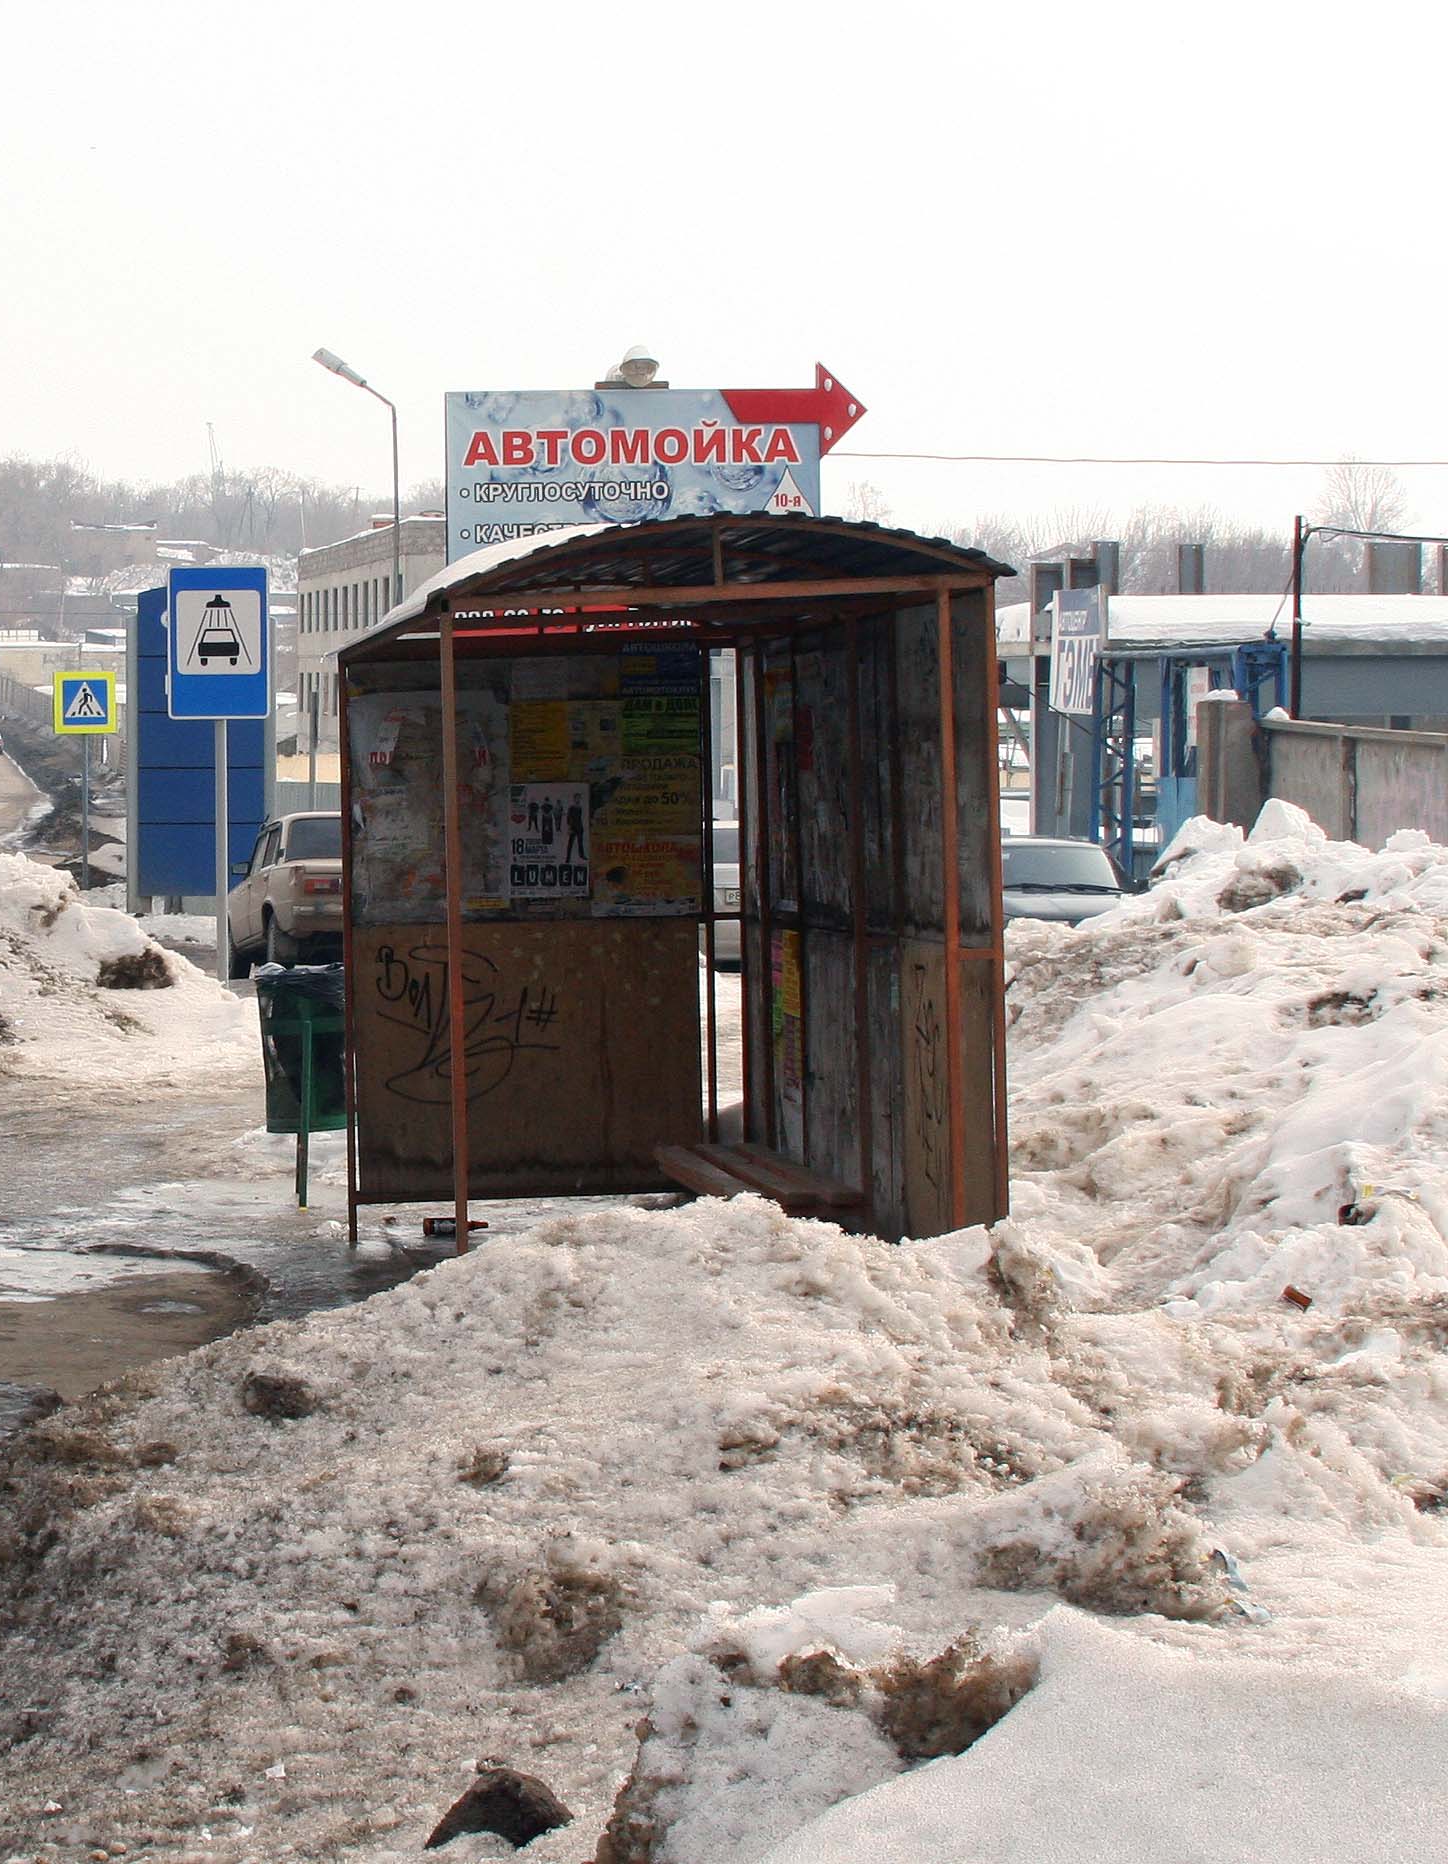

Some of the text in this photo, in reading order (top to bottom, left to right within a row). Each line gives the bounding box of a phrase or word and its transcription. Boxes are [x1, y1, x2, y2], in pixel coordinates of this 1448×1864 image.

[463, 420, 800, 466] АВТОМОЙКА
[475, 481, 669, 502] КРУГЛОСУТОЧНО
[512, 838, 524, 855] 18
[512, 868, 586, 885] LUMEN
